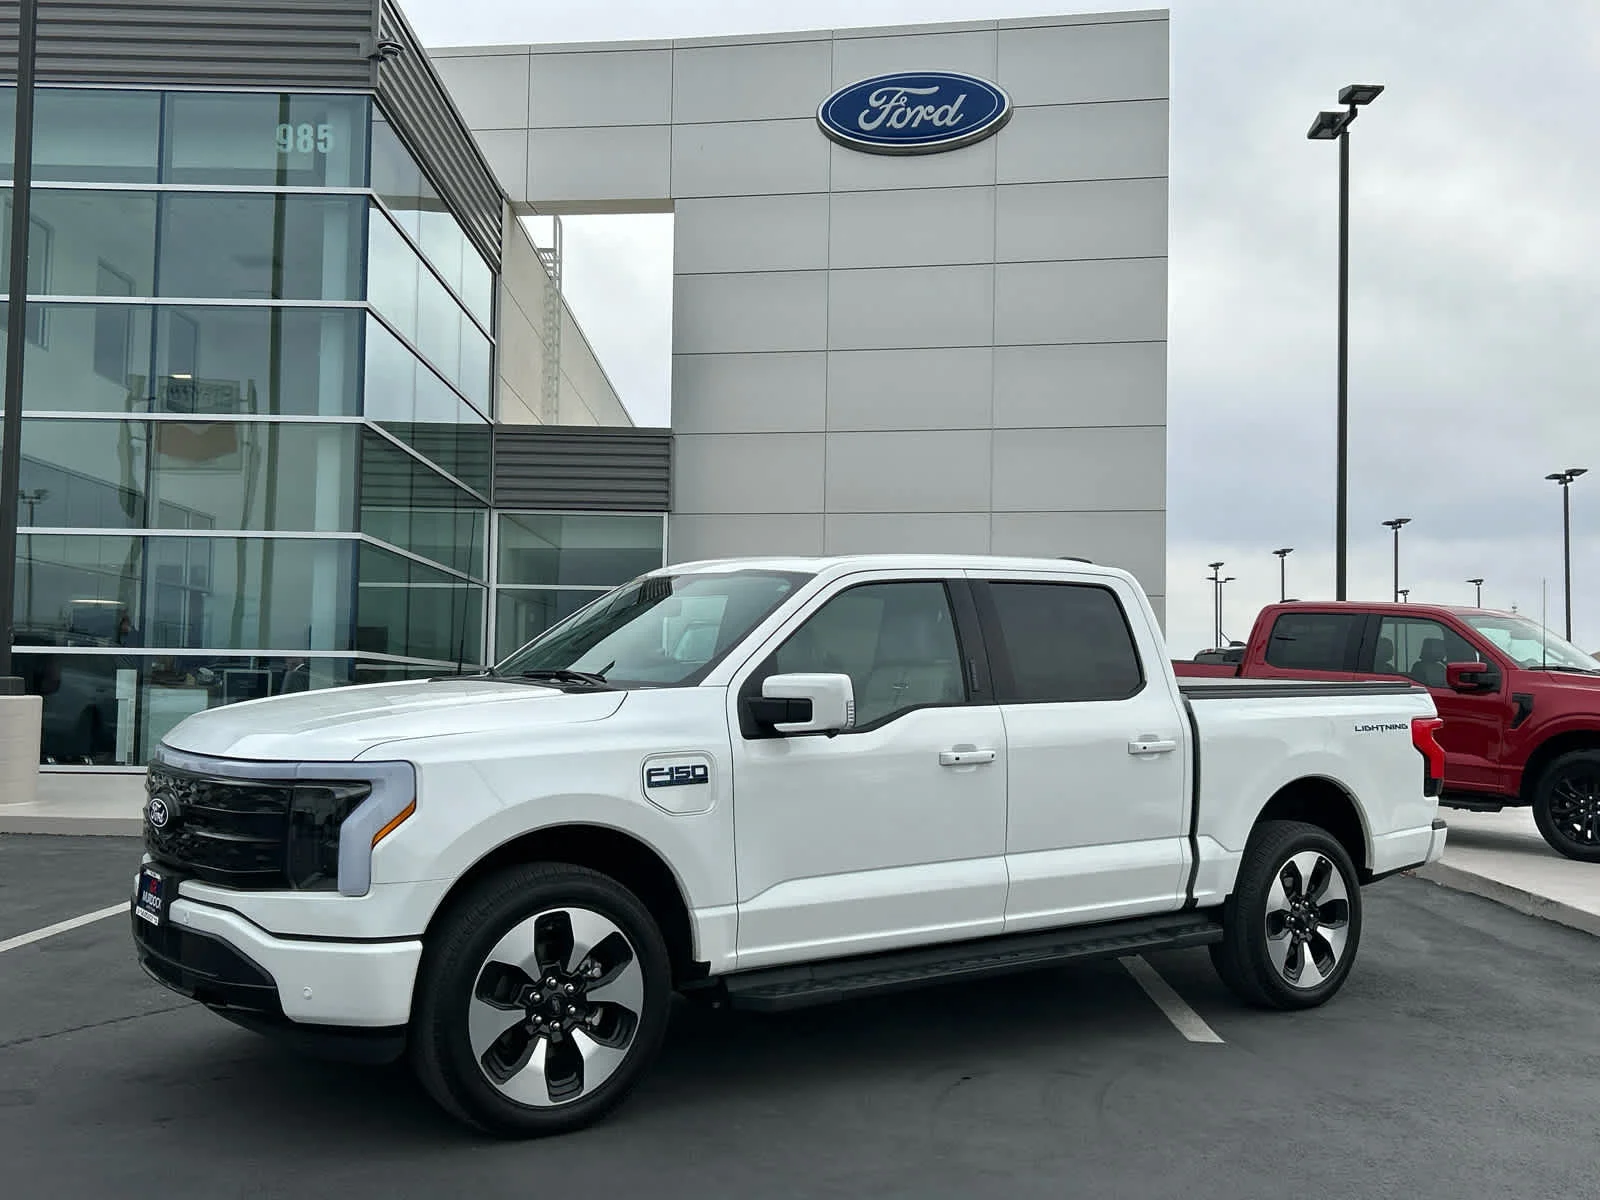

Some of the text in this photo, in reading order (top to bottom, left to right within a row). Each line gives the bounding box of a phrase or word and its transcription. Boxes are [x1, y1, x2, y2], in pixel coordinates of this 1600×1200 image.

[858, 86, 967, 131] Ford
[276, 123, 333, 152] 985
[1354, 723, 1408, 733] LIGHTNING
[647, 764, 708, 787] F-150
